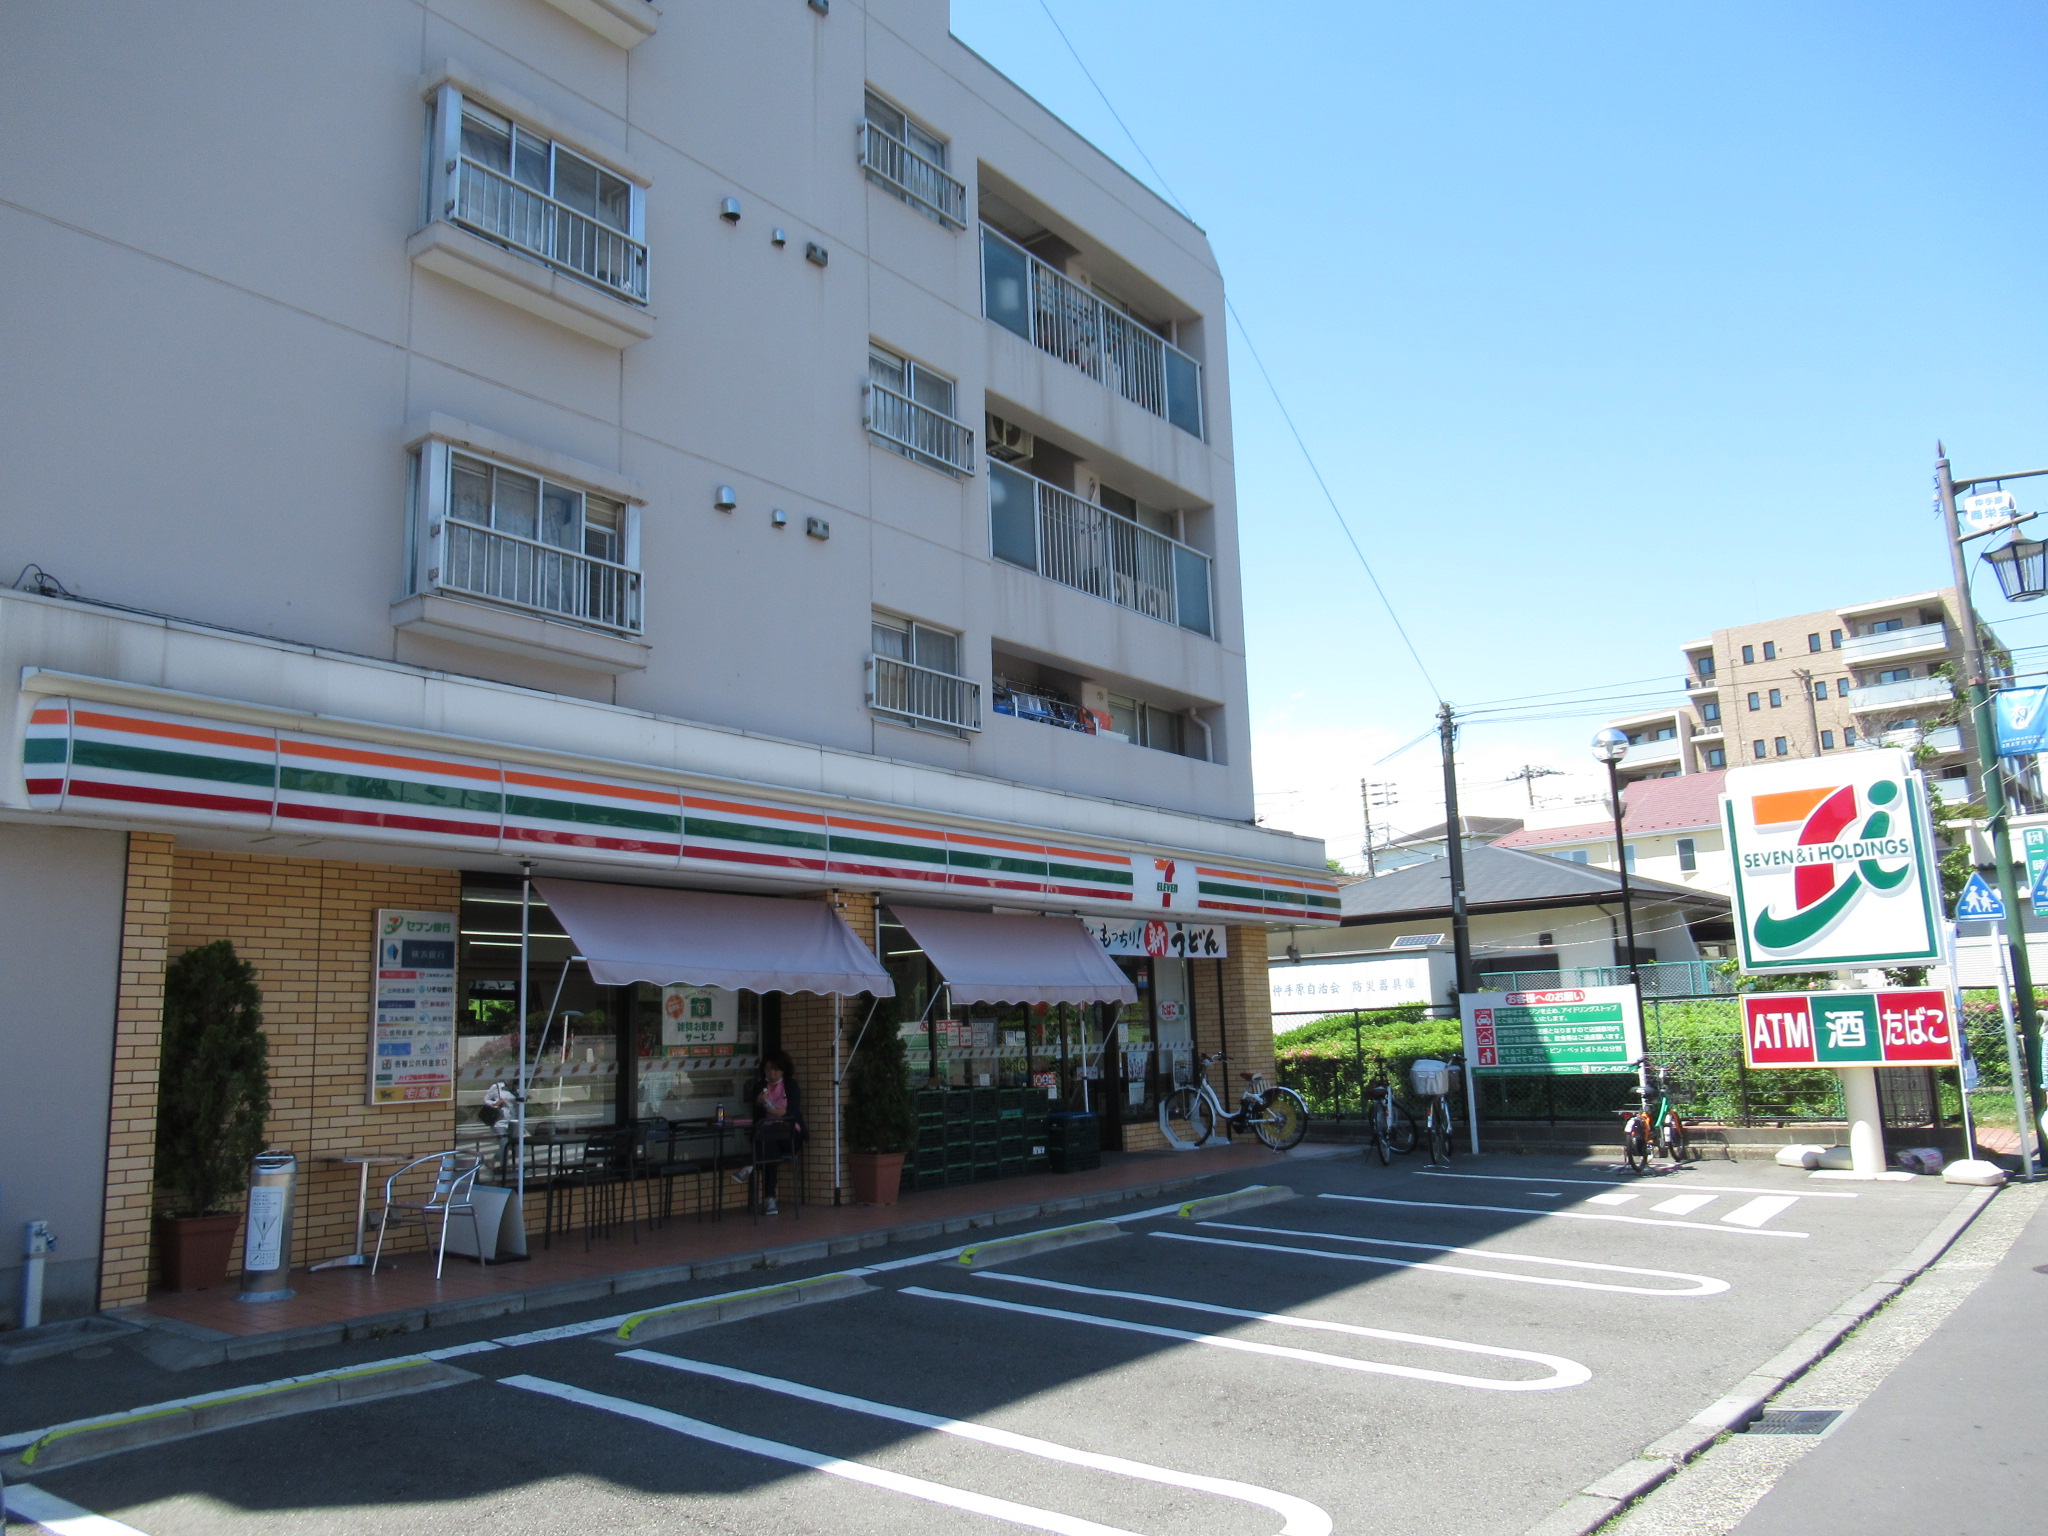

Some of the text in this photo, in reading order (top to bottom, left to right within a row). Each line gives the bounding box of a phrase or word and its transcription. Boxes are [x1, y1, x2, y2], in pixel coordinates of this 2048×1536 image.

[1819, 838, 1909, 861] HOLDINGS
[406, 920, 451, 934] セブン銀行
[1171, 922, 1220, 958] うどん
[411, 950, 446, 959] 横浜銀行
[1272, 976, 1416, 997] 仲手原自治会 防災器具庫
[1507, 991, 1584, 1005] お客様へのお願い
[1161, 1003, 1176, 1016] たばこ
[677, 1020, 725, 1032] 雑誌お取置き
[1754, 1010, 1809, 1050] ATM
[1828, 1009, 1866, 1048] 酒
[1882, 1006, 1949, 1046] たばこ
[685, 1032, 716, 1043] サービス
[405, 1087, 441, 1099] 宅急便
